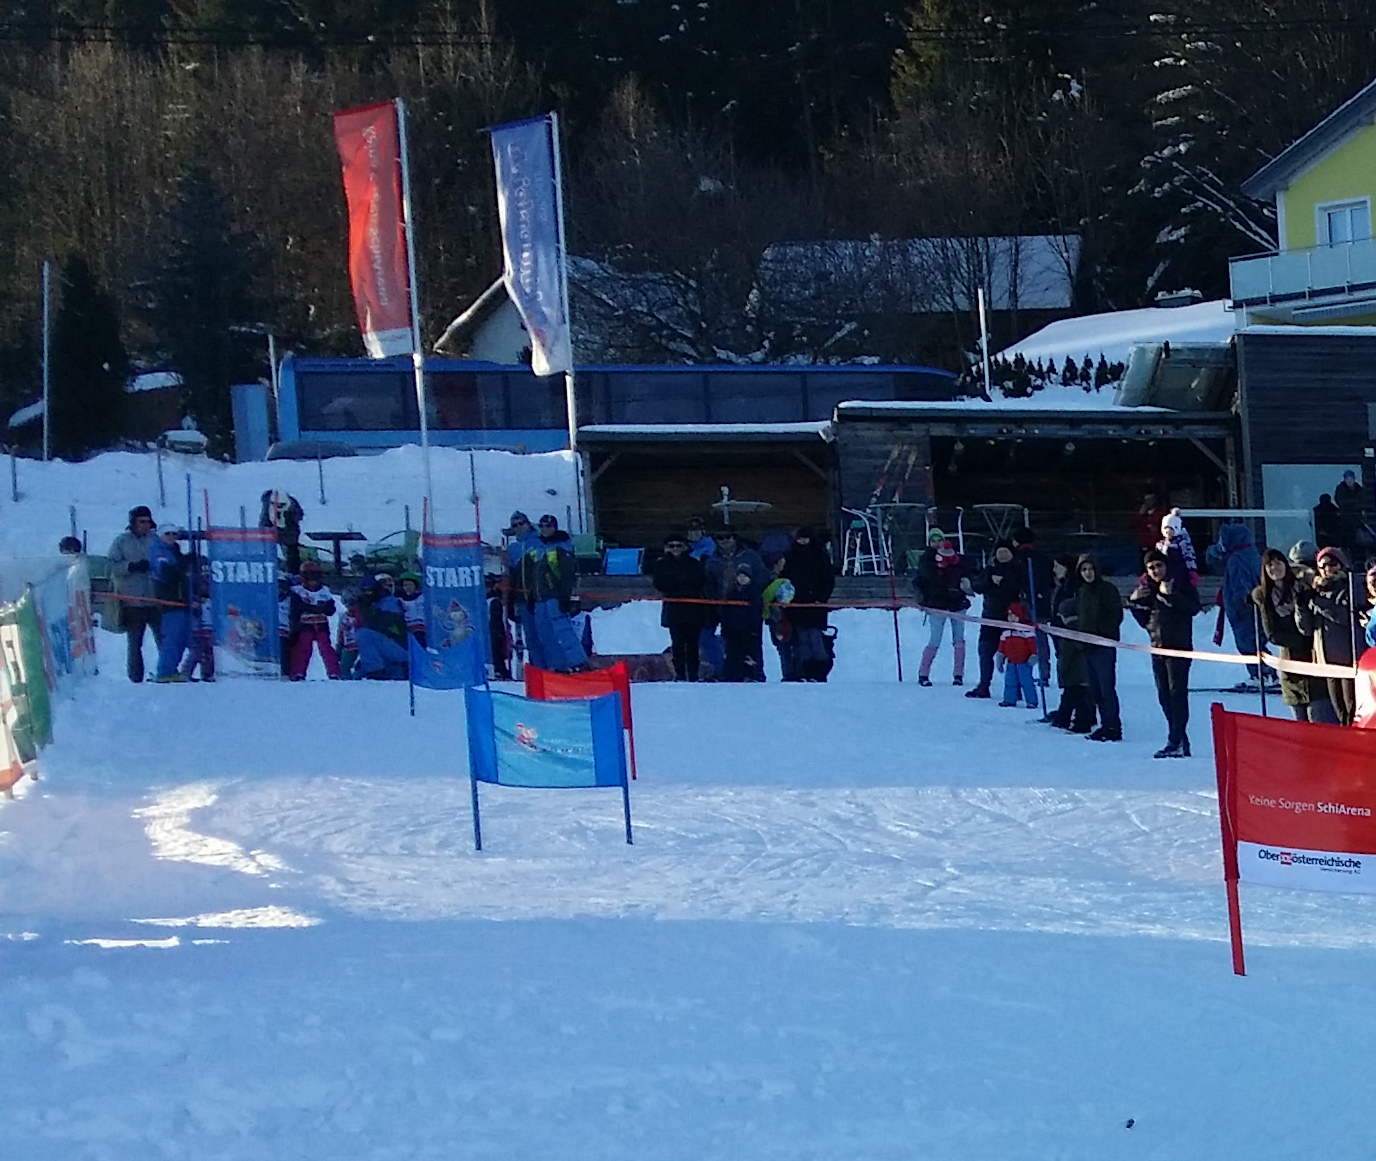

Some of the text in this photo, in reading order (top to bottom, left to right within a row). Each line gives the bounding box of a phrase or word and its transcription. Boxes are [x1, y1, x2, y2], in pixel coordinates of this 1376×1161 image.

[211, 561, 275, 584] START
[426, 565, 481, 588] START
[1278, 798, 1315, 814] Sorgen
[1316, 801, 1372, 817] SchiArena
